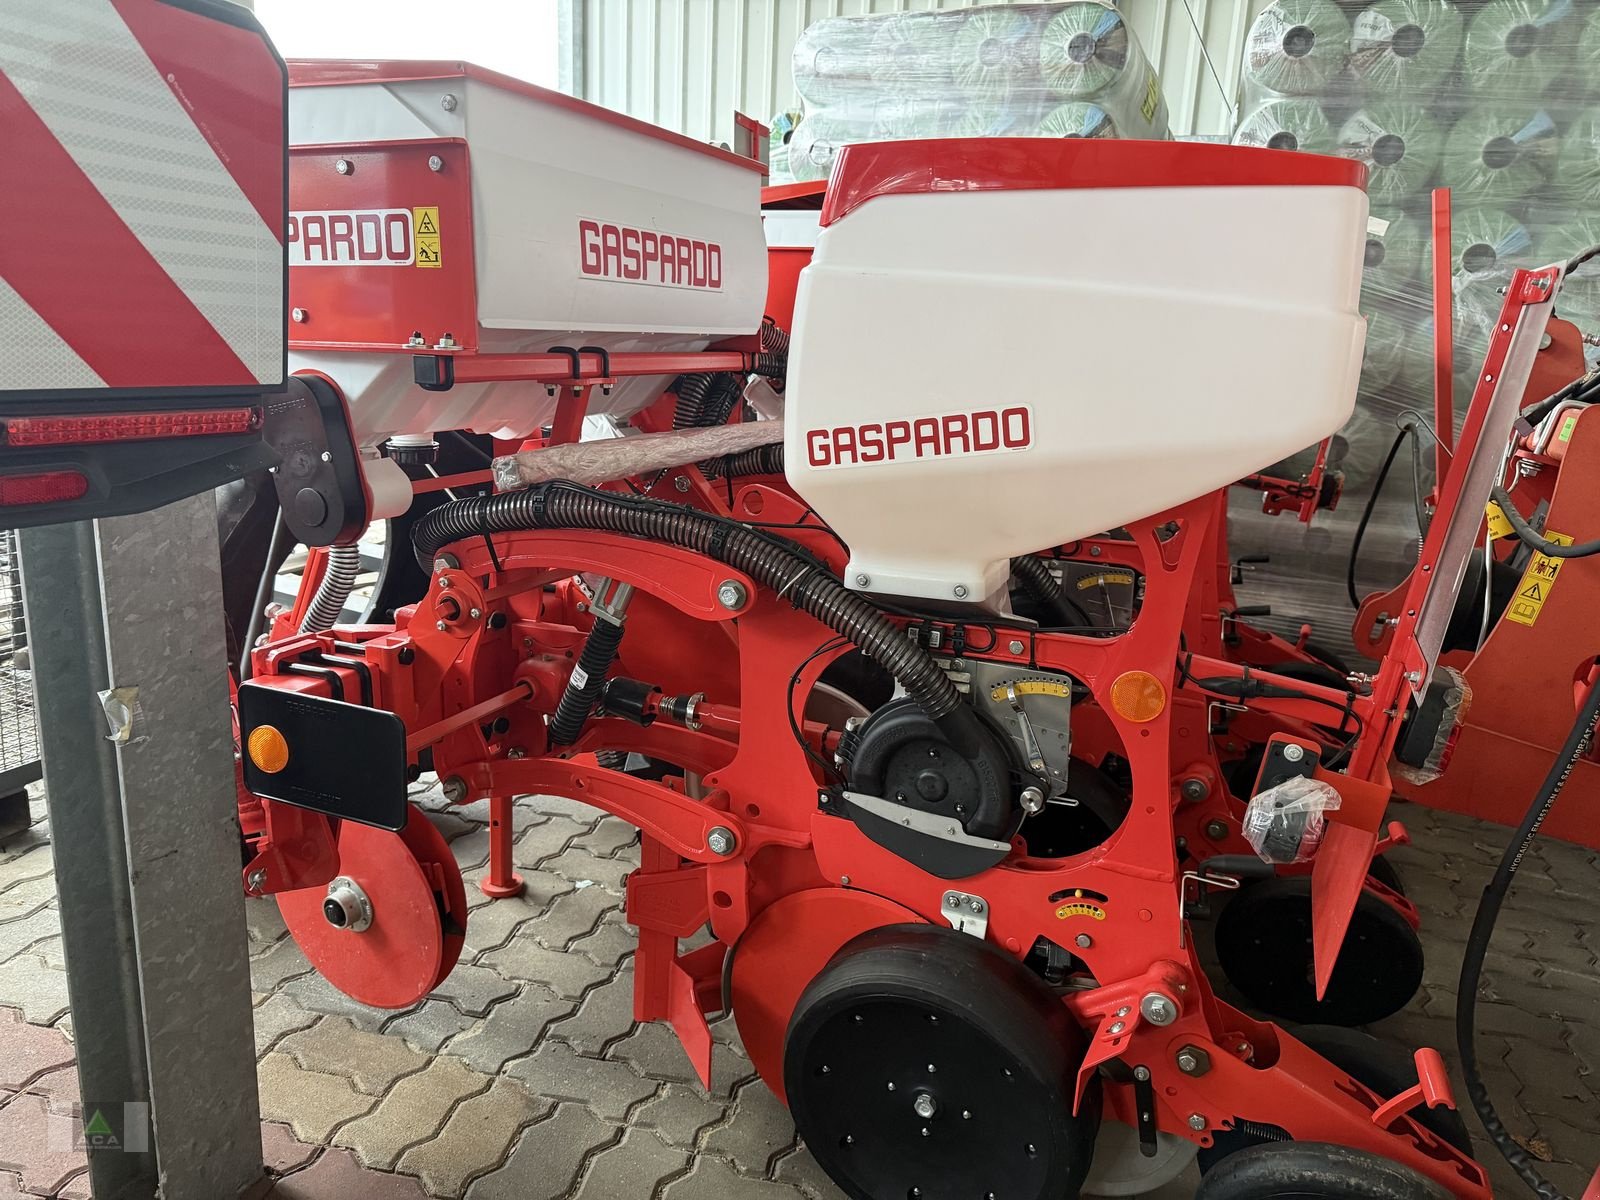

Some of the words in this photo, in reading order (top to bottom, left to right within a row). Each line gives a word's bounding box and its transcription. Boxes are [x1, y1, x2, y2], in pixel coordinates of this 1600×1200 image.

[579, 220, 721, 288] GASPARDO
[806, 407, 1030, 467] GASPARDO
[1509, 832, 1535, 872] HYDRAULIC
[1561, 763, 1574, 781] SAE
[1571, 728, 1592, 762] 100R2AT
